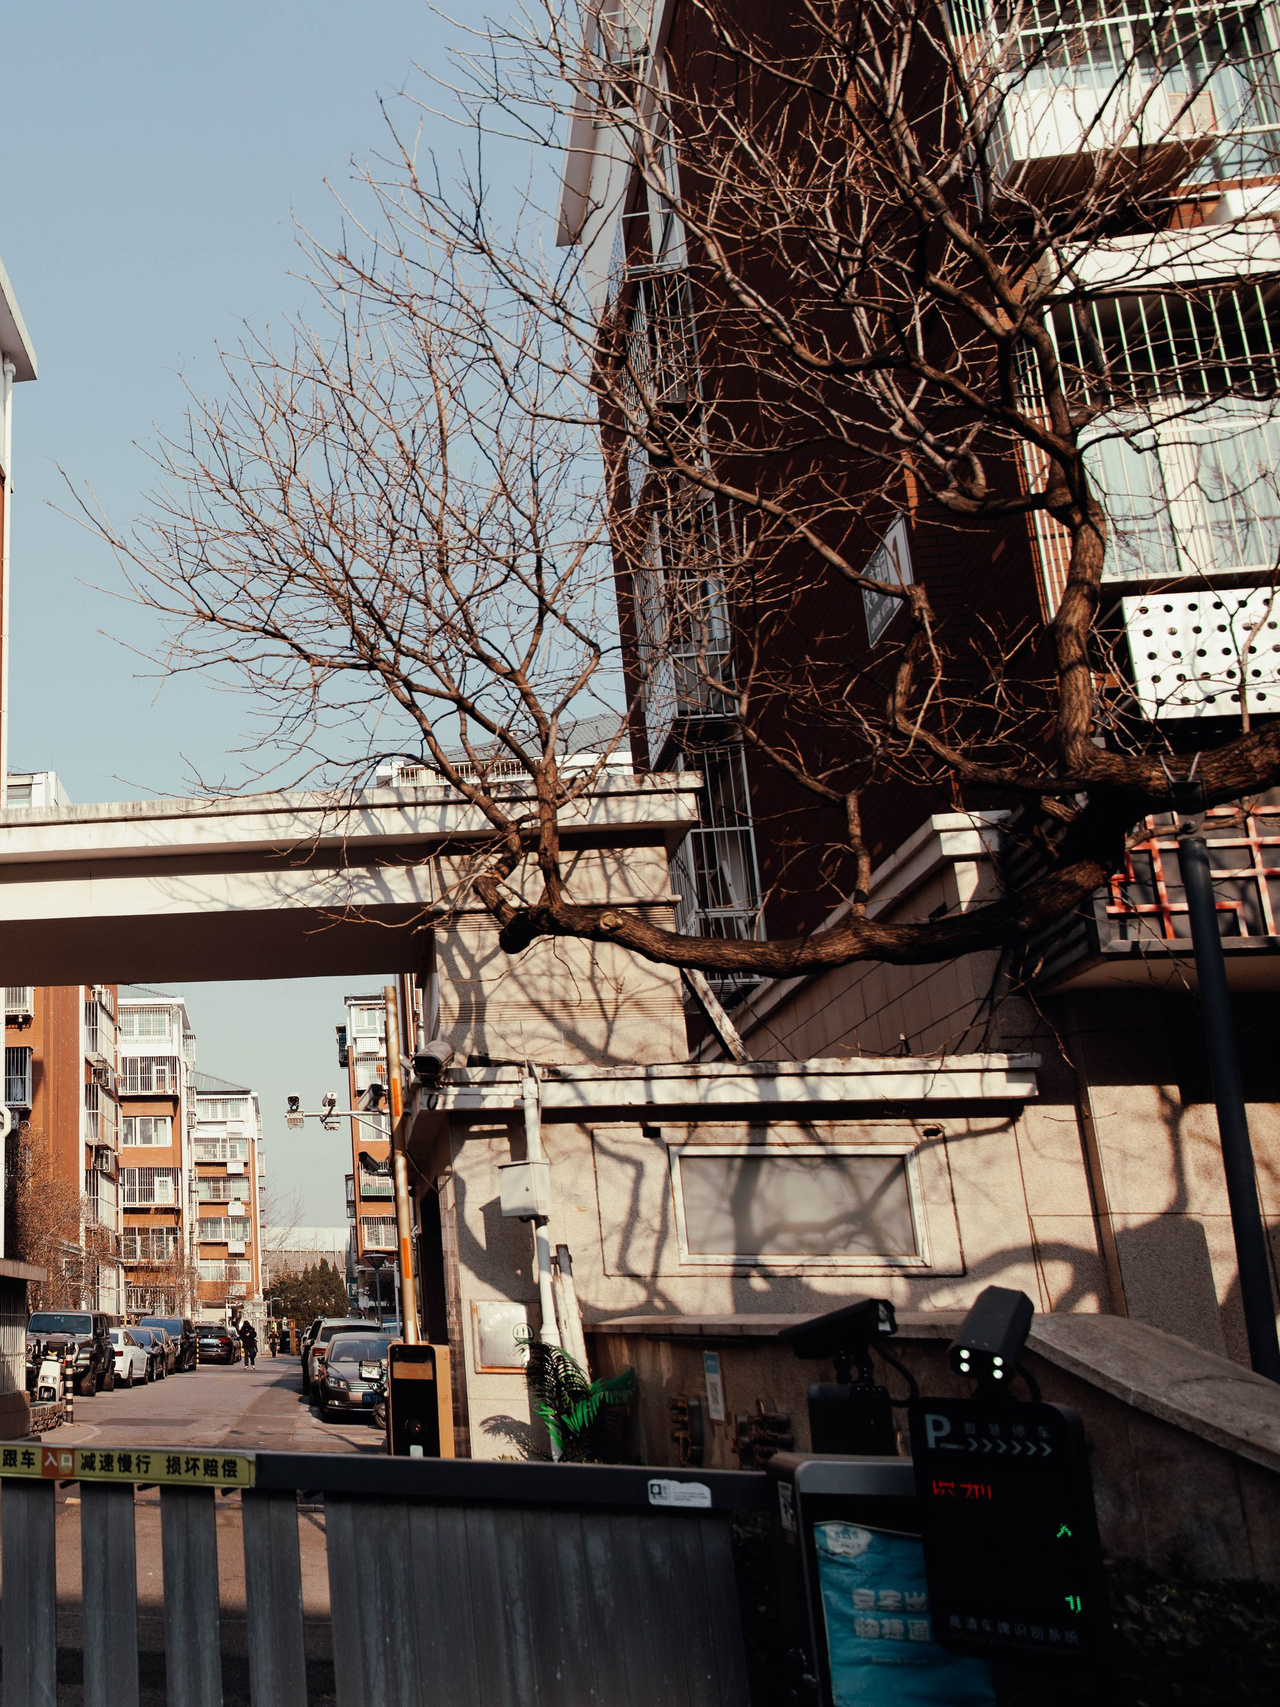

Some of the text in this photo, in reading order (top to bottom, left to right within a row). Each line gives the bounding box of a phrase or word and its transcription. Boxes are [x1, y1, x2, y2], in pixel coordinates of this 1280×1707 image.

[924, 1413, 952, 1449] P
[44, 1450, 74, 1469] 入口
[80, 1452, 152, 1475] 减速慢行
[165, 1455, 239, 1479] 损坏赔偿
[948, 1613, 1081, 1646] 高清车牌识别系统
